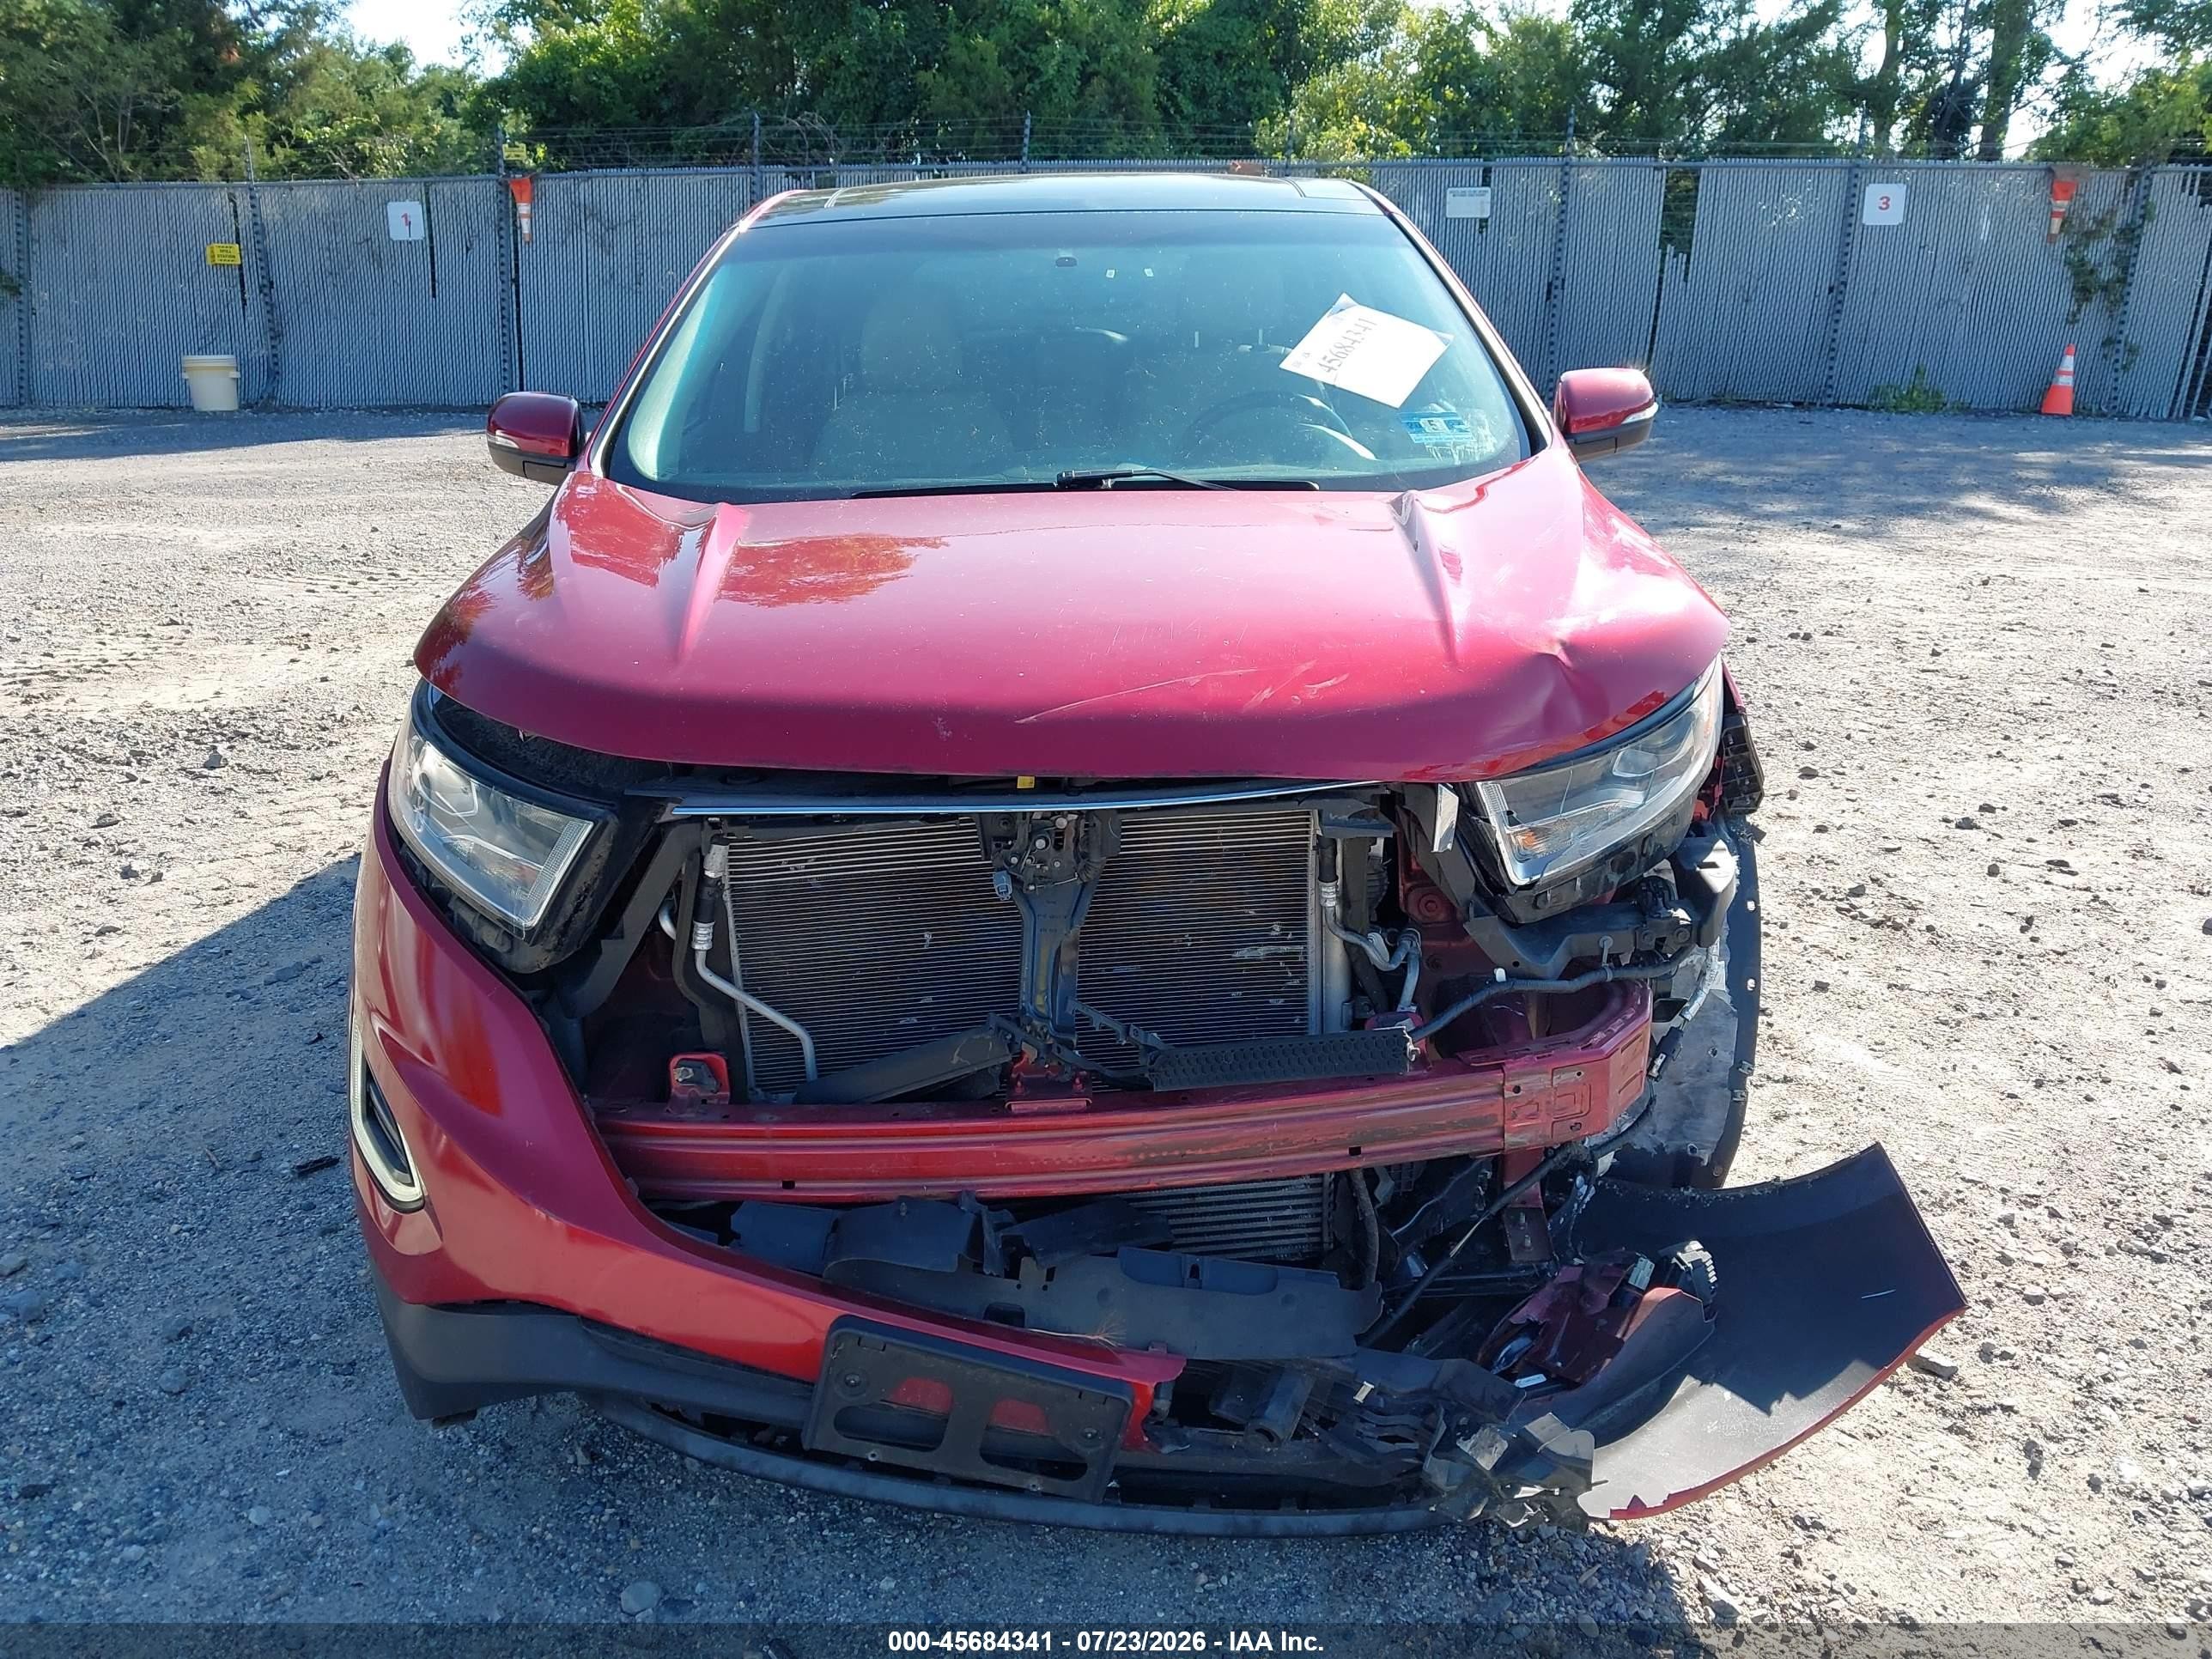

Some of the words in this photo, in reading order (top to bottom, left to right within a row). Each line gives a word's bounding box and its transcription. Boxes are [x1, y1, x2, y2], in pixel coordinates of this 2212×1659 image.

[1878, 195, 1891, 211] 3
[401, 212, 409, 227] 1
[1317, 317, 1378, 373] 45684341
[1426, 418, 1440, 432] 5
